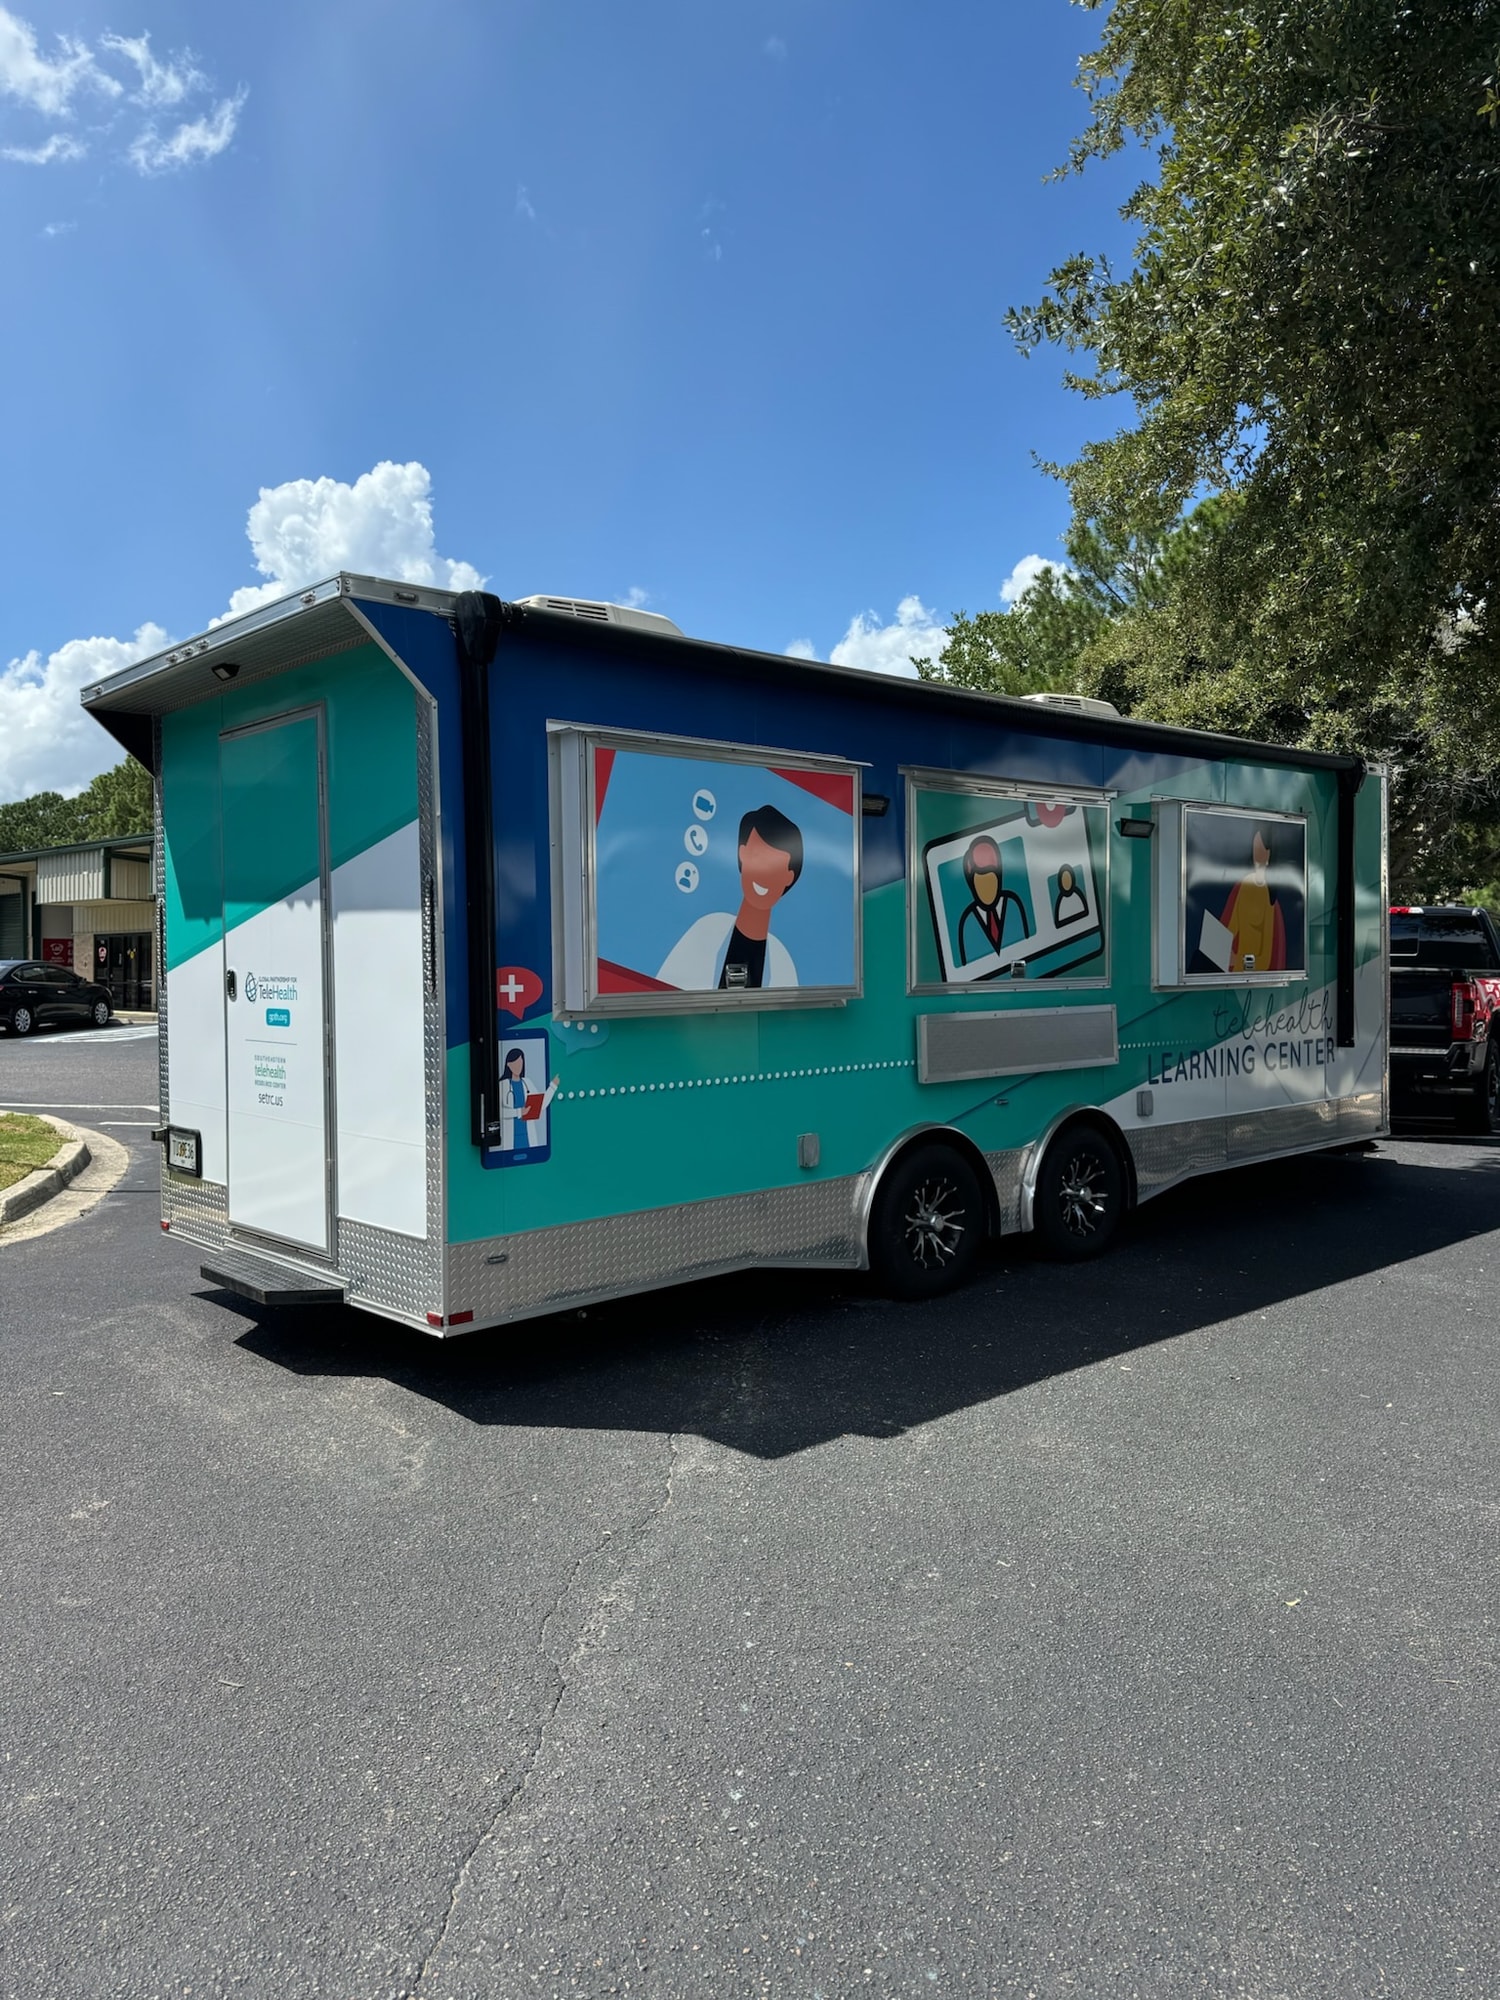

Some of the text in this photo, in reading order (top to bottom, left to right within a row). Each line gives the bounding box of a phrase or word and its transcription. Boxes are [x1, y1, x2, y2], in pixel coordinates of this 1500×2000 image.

[258, 984, 298, 1001] TeleHealth
[1213, 987, 1333, 1039] telehealth
[1147, 1037, 1335, 1085] LEARNING CENTER
[254, 1063, 287, 1080] telehealth
[258, 1092, 284, 1107] setrc.us
